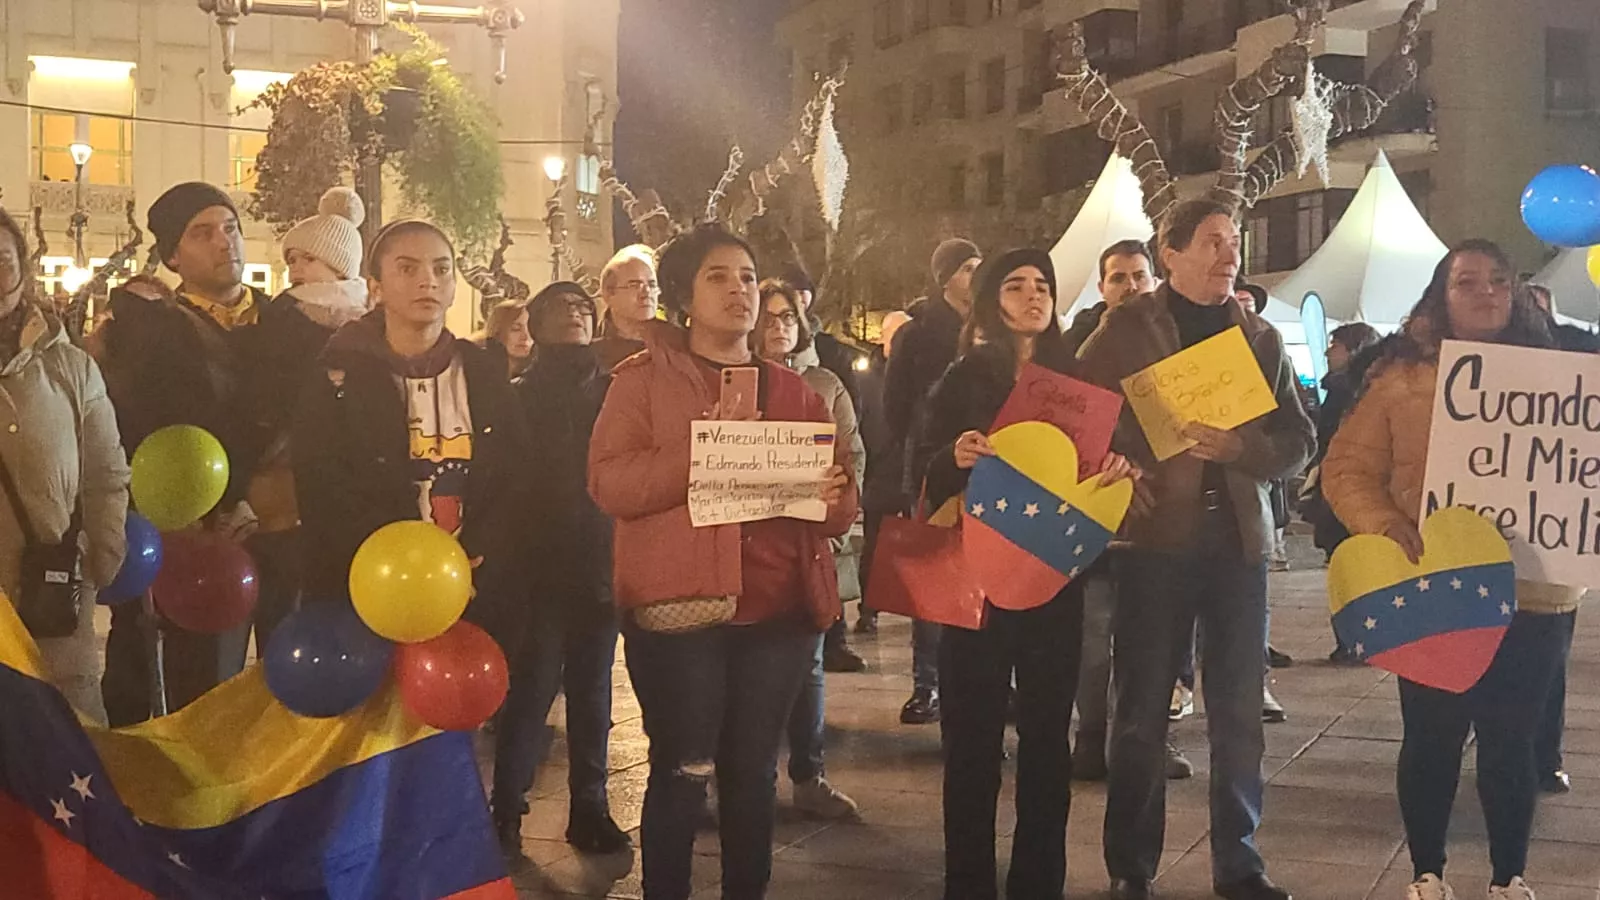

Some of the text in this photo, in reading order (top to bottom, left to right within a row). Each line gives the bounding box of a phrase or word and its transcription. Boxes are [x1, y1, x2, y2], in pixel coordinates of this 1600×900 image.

[1444, 353, 1600, 432] Cuando
[706, 453, 763, 471] Edmundo
[767, 450, 828, 470] Presidente
[1468, 433, 1600, 489] el Mie
[1528, 490, 1569, 550] la
